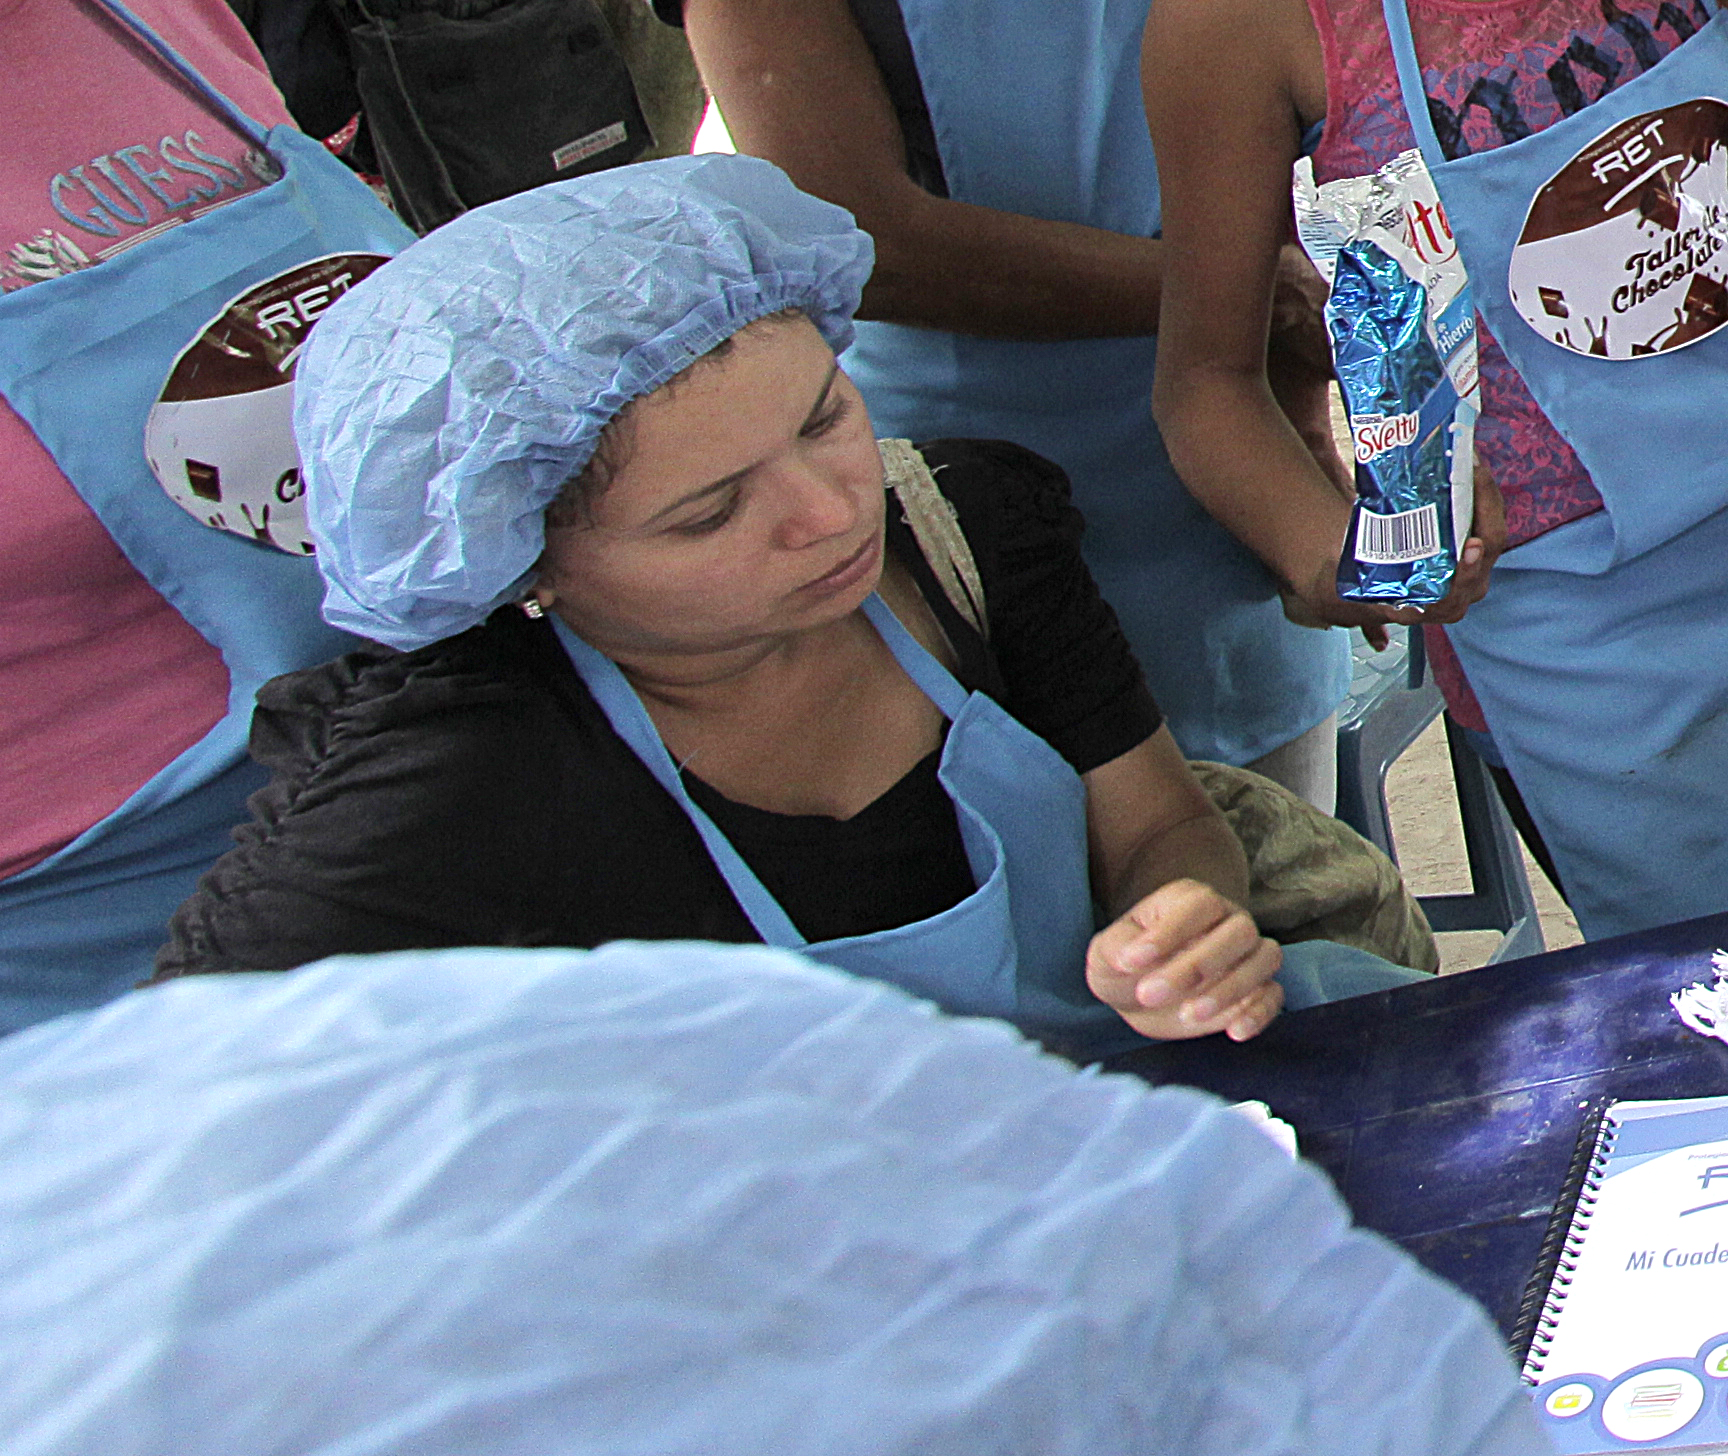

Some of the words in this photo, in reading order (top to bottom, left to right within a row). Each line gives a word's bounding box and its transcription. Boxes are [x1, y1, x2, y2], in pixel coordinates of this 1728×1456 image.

[1592, 119, 1664, 184] RET
[50, 129, 246, 237] GUESS
[1624, 227, 1704, 280] Taller
[257, 272, 352, 339] RET
[1438, 316, 1474, 354] Hierro
[1358, 414, 1418, 461] Svelty
[1625, 1250, 1656, 1271] Mi
